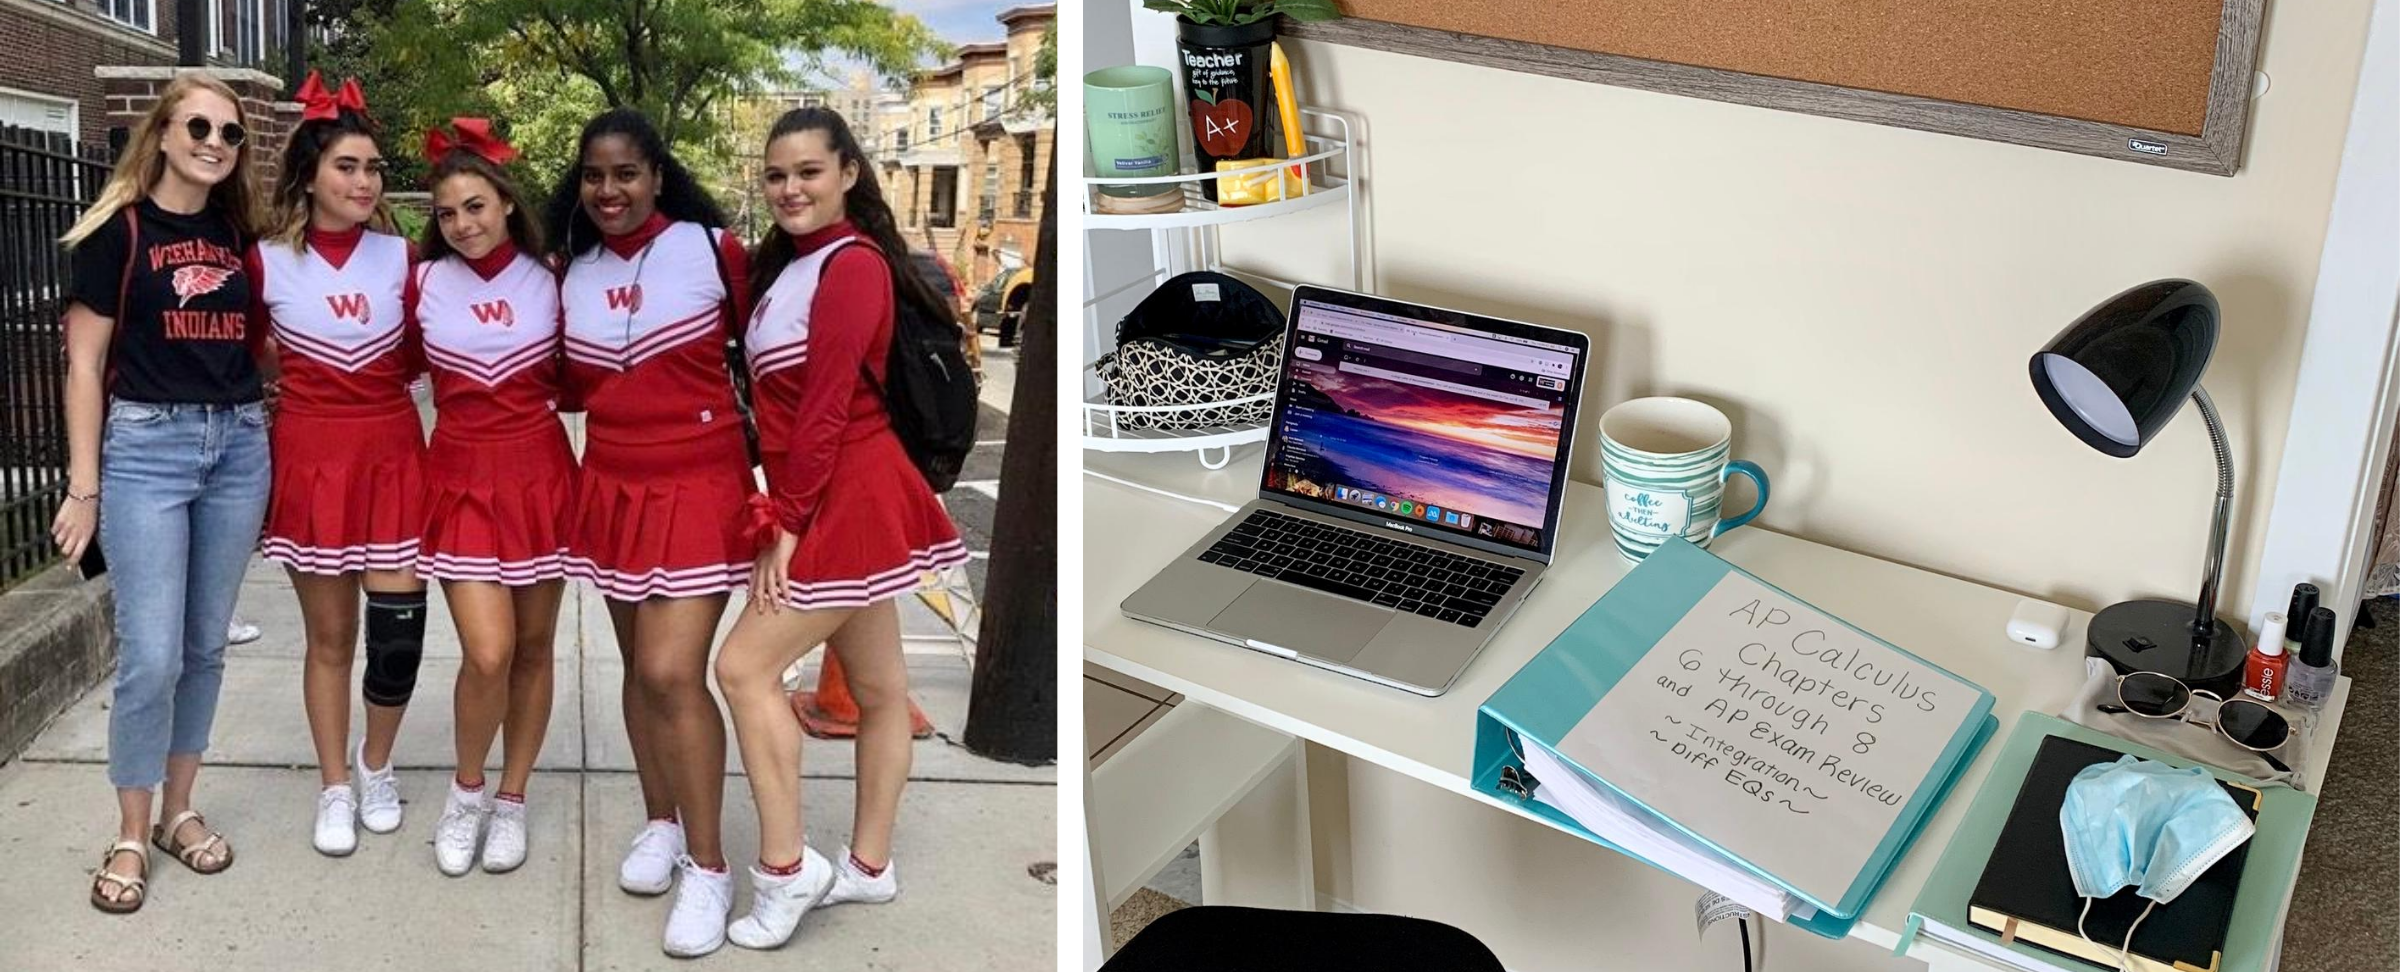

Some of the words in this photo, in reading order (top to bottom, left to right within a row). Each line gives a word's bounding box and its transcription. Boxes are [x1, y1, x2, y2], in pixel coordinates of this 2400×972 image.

[1181, 49, 1243, 68] Teacher
[1202, 69, 1208, 78] of
[1140, 106, 1166, 118] RELIEF
[1205, 114, 1239, 142] A+
[163, 311, 246, 340] INDIANS
[1624, 493, 1662, 507] coffee
[1618, 511, 1671, 532] adulting
[1729, 599, 1790, 628] AP
[1792, 630, 1935, 712] Calculus
[1738, 643, 1884, 723] Chapters
[2260, 667, 2274, 697] essie
[1679, 649, 1703, 671] 6
[1719, 668, 1828, 734] through
[1852, 731, 1876, 754] 8
[1656, 675, 1693, 697] and
[1705, 698, 1748, 724] AP
[1750, 721, 1816, 763] Exam
[1819, 755, 1902, 806] Review
